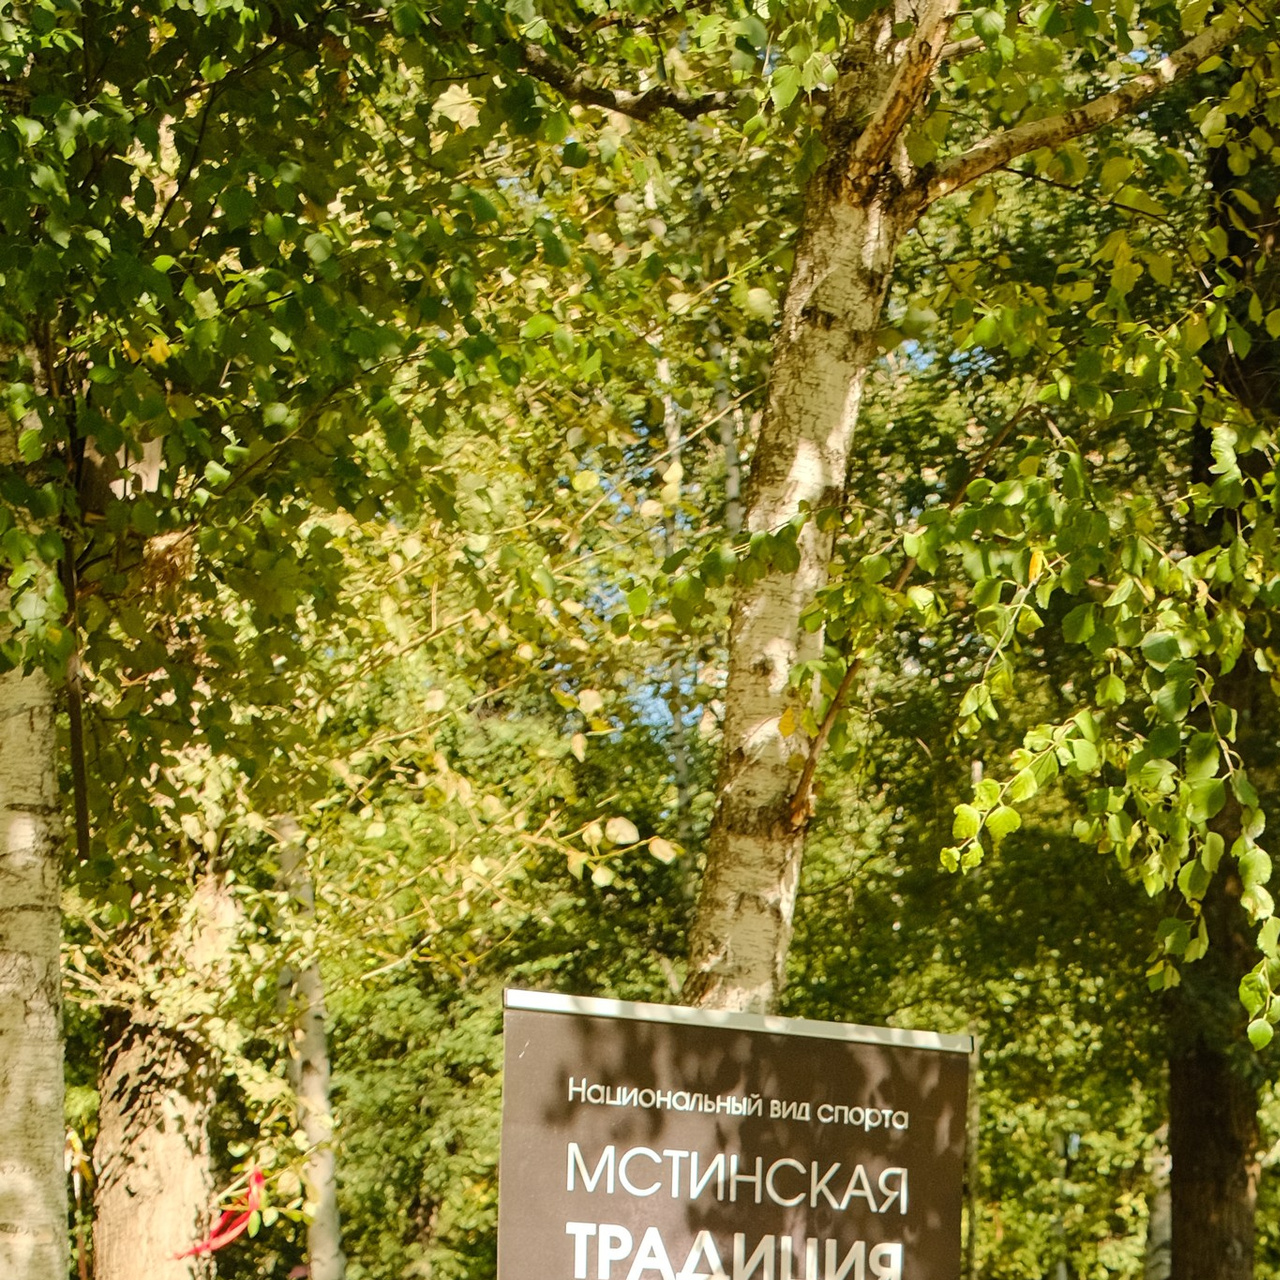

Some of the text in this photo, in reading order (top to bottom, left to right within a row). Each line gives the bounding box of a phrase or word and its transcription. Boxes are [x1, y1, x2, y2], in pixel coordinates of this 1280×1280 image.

[568, 1077, 909, 1132] Национальный вид спорта
[566, 1142, 908, 1215] МСТИНСКАЯ
